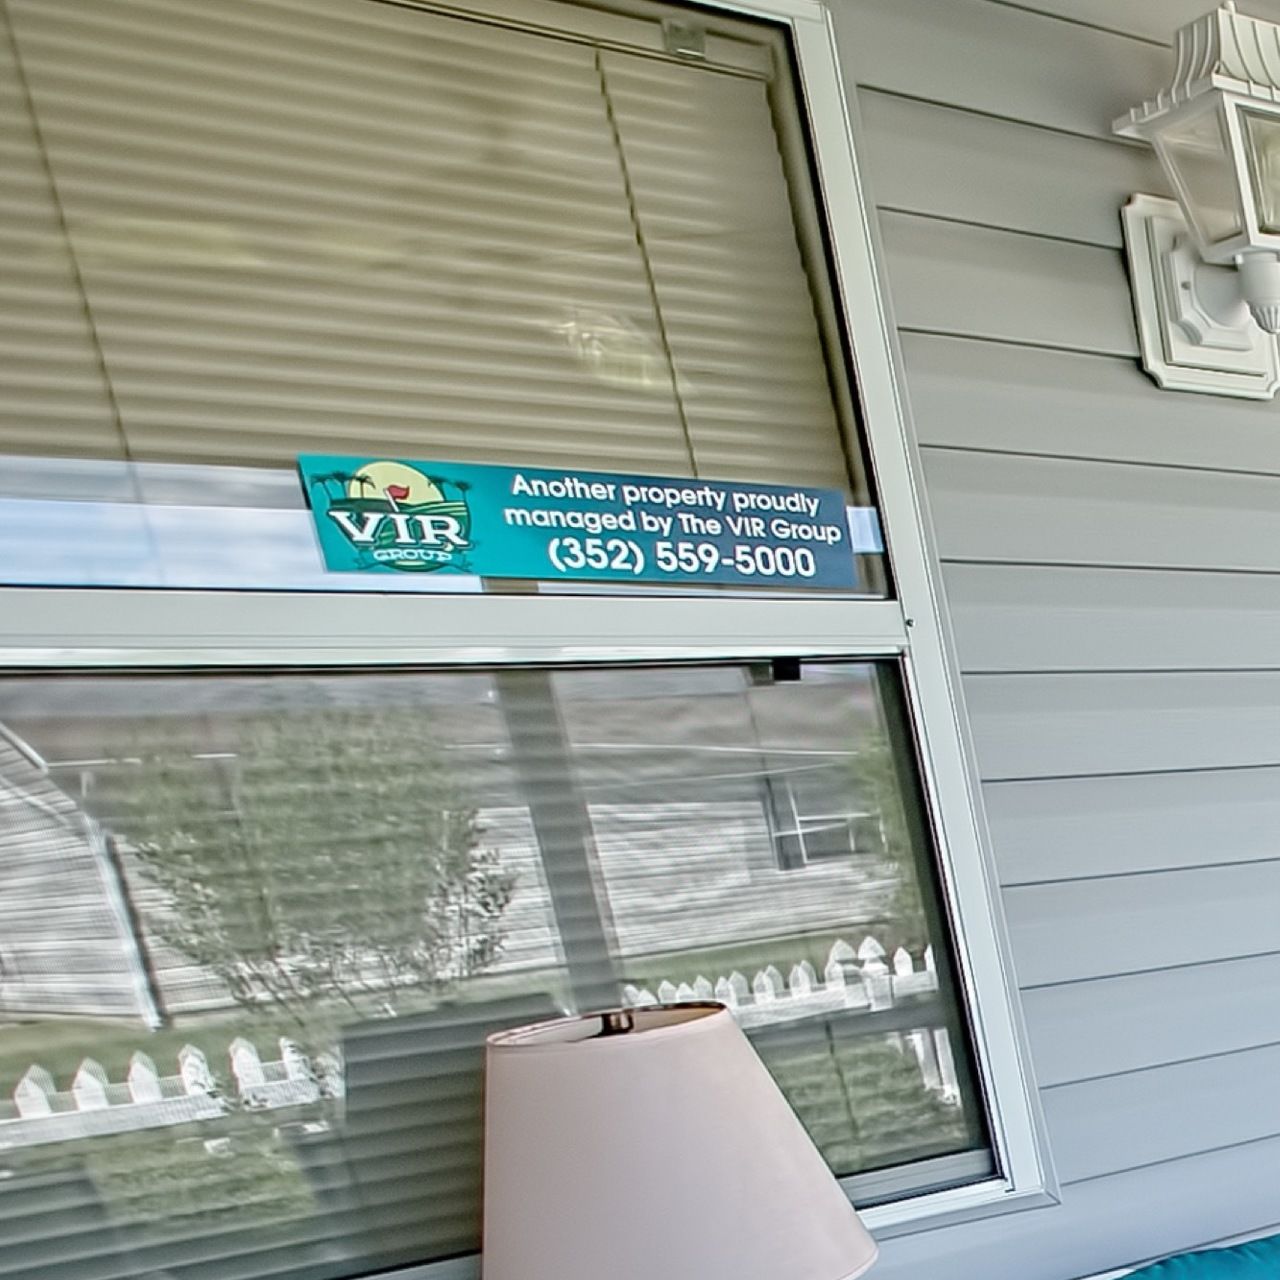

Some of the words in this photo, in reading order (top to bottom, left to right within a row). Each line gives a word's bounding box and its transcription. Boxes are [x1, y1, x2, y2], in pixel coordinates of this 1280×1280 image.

[511, 474, 616, 501] Another
[623, 484, 726, 511] property
[732, 490, 820, 518] proudly
[328, 510, 471, 547] VIR
[504, 507, 637, 534] managed
[643, 509, 671, 538] by
[678, 514, 722, 537] The
[725, 518, 766, 539] VIR
[771, 519, 842, 545] Group
[372, 547, 453, 561] GROUP
[548, 538, 644, 575] (352)
[656, 541, 816, 578] 559-5000
